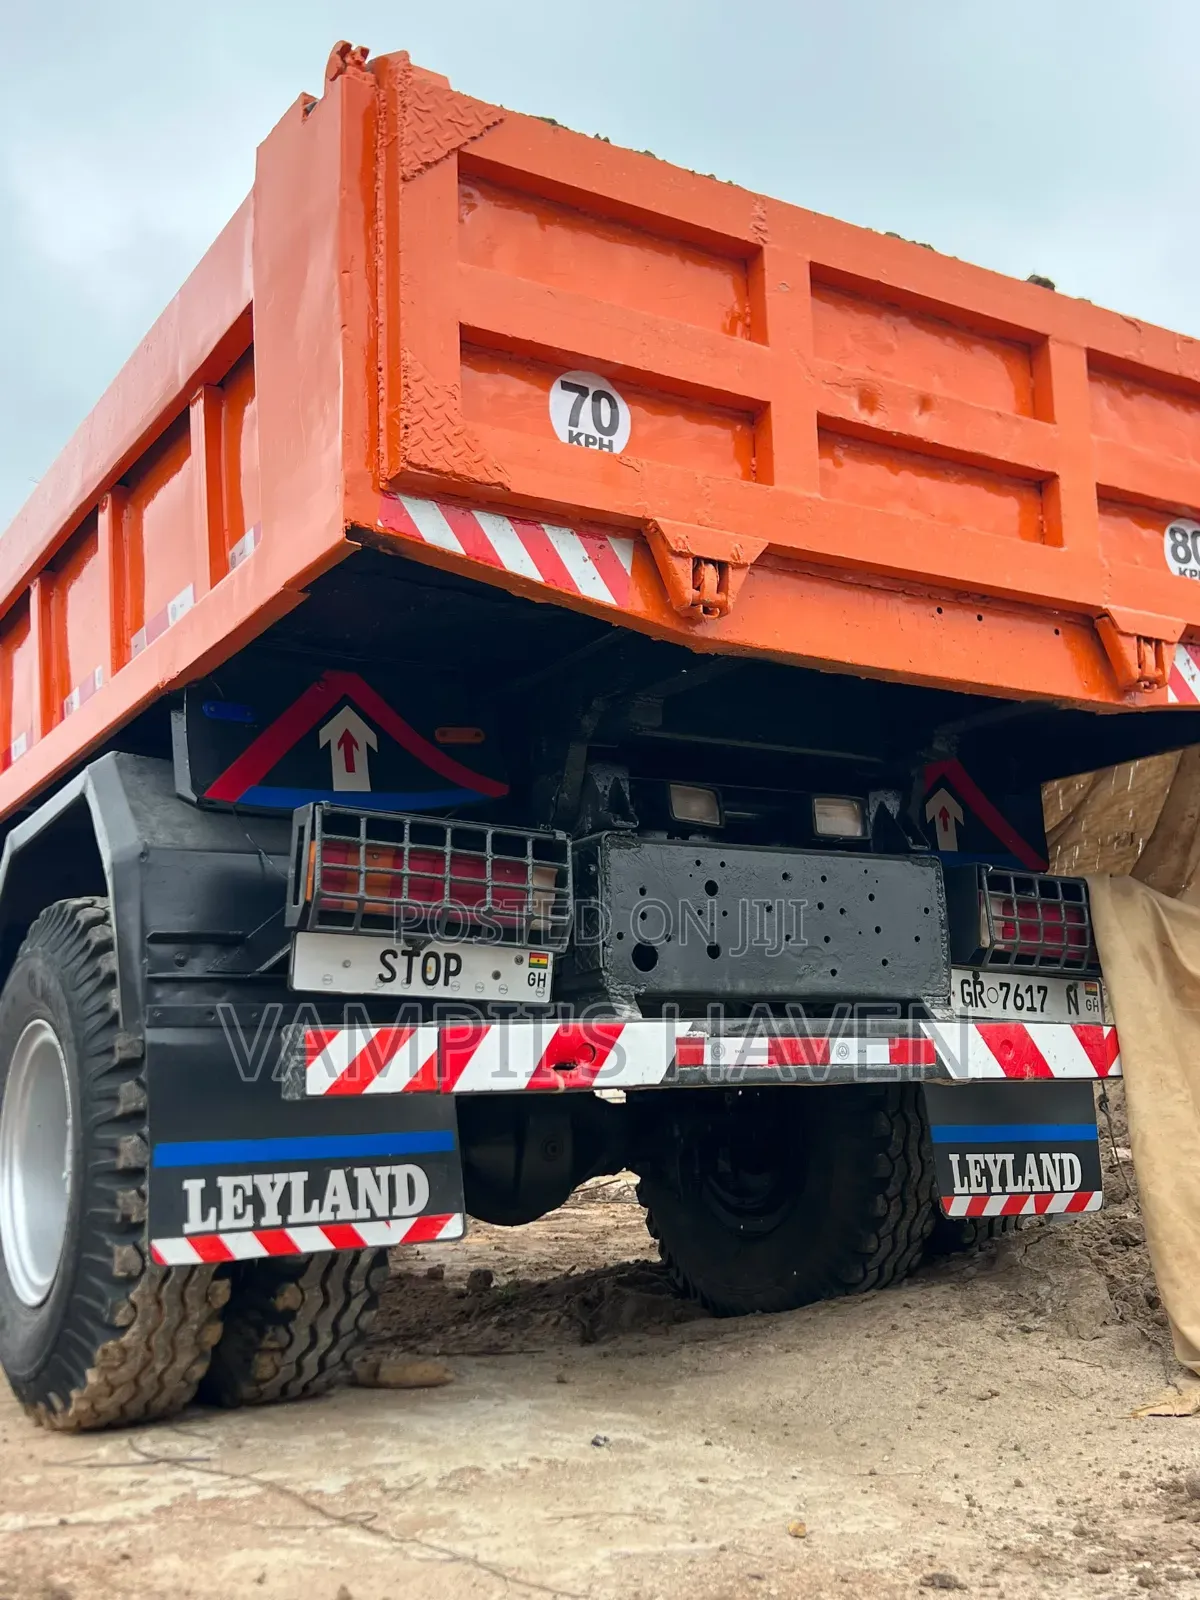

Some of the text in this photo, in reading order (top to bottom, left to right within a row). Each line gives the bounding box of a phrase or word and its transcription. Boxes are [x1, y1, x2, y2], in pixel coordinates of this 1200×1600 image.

[560, 380, 620, 437] 70
[568, 429, 614, 453] KPH
[1178, 567, 1200, 580] KP
[378, 949, 463, 987] STOP
[527, 971, 547, 988] GH
[960, 978, 1080, 1016] GR 7617 N
[1085, 999, 1100, 1013] GH
[949, 1153, 1082, 1194] LEYLAND
[182, 1163, 430, 1235] LEYLAND
